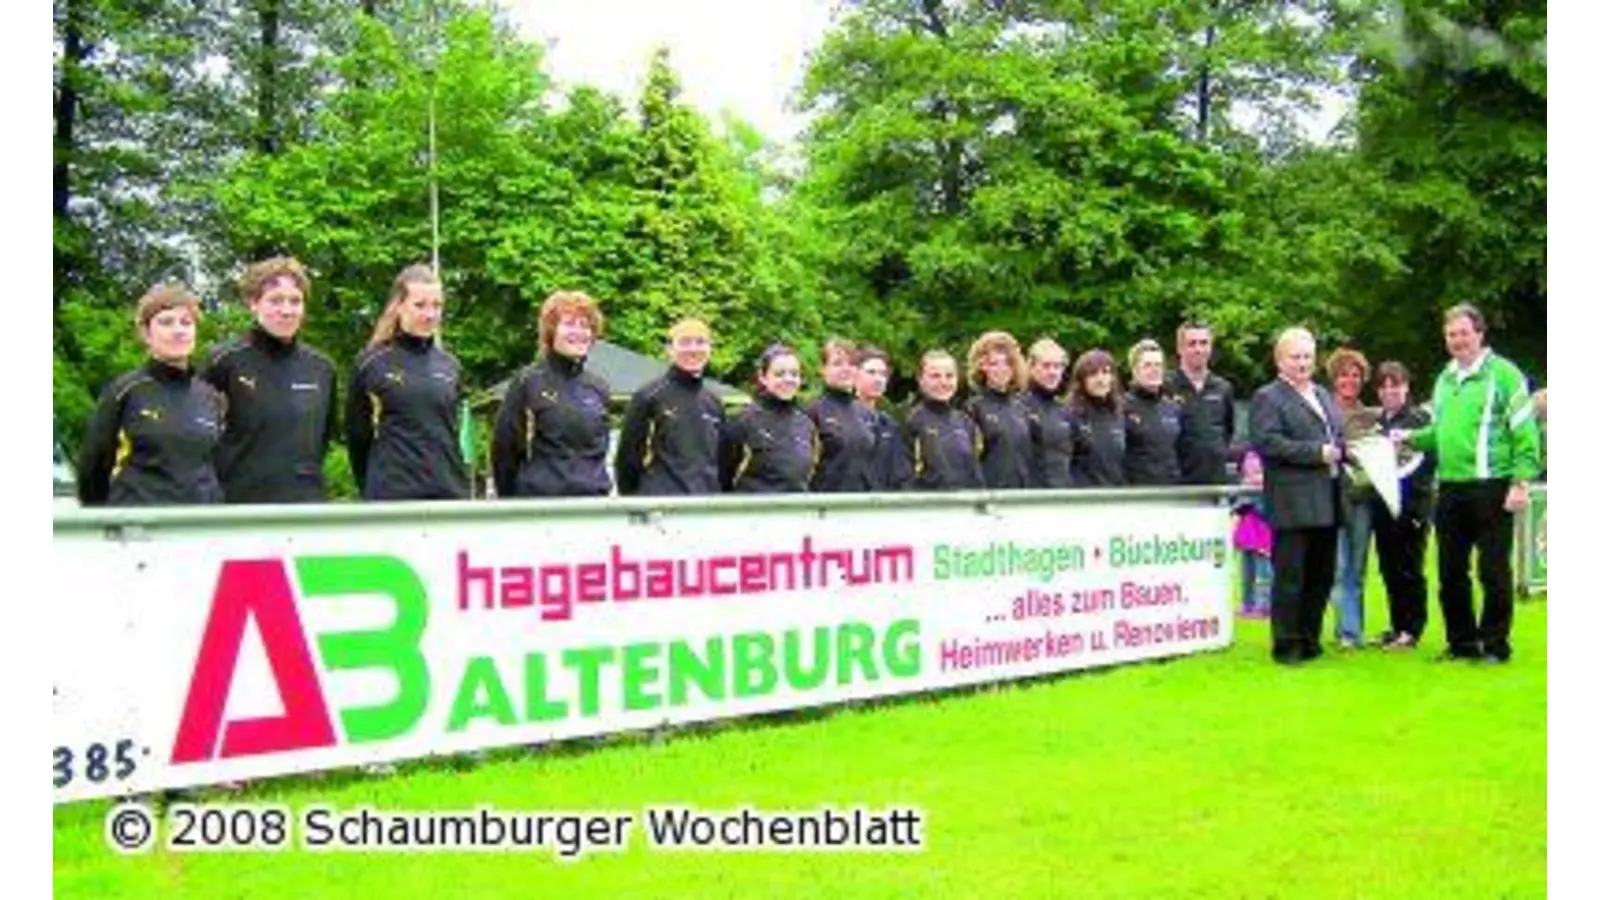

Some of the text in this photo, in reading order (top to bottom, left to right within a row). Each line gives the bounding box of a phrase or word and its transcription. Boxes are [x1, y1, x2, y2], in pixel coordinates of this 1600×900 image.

[457, 536, 914, 620] hagebaucentrum
[932, 541, 1086, 582] Stadthagen
[1012, 589, 1065, 621] alles
[1071, 587, 1115, 614] zum
[940, 629, 1084, 673] Heimwerken
[445, 618, 921, 733] ALTENBURG
